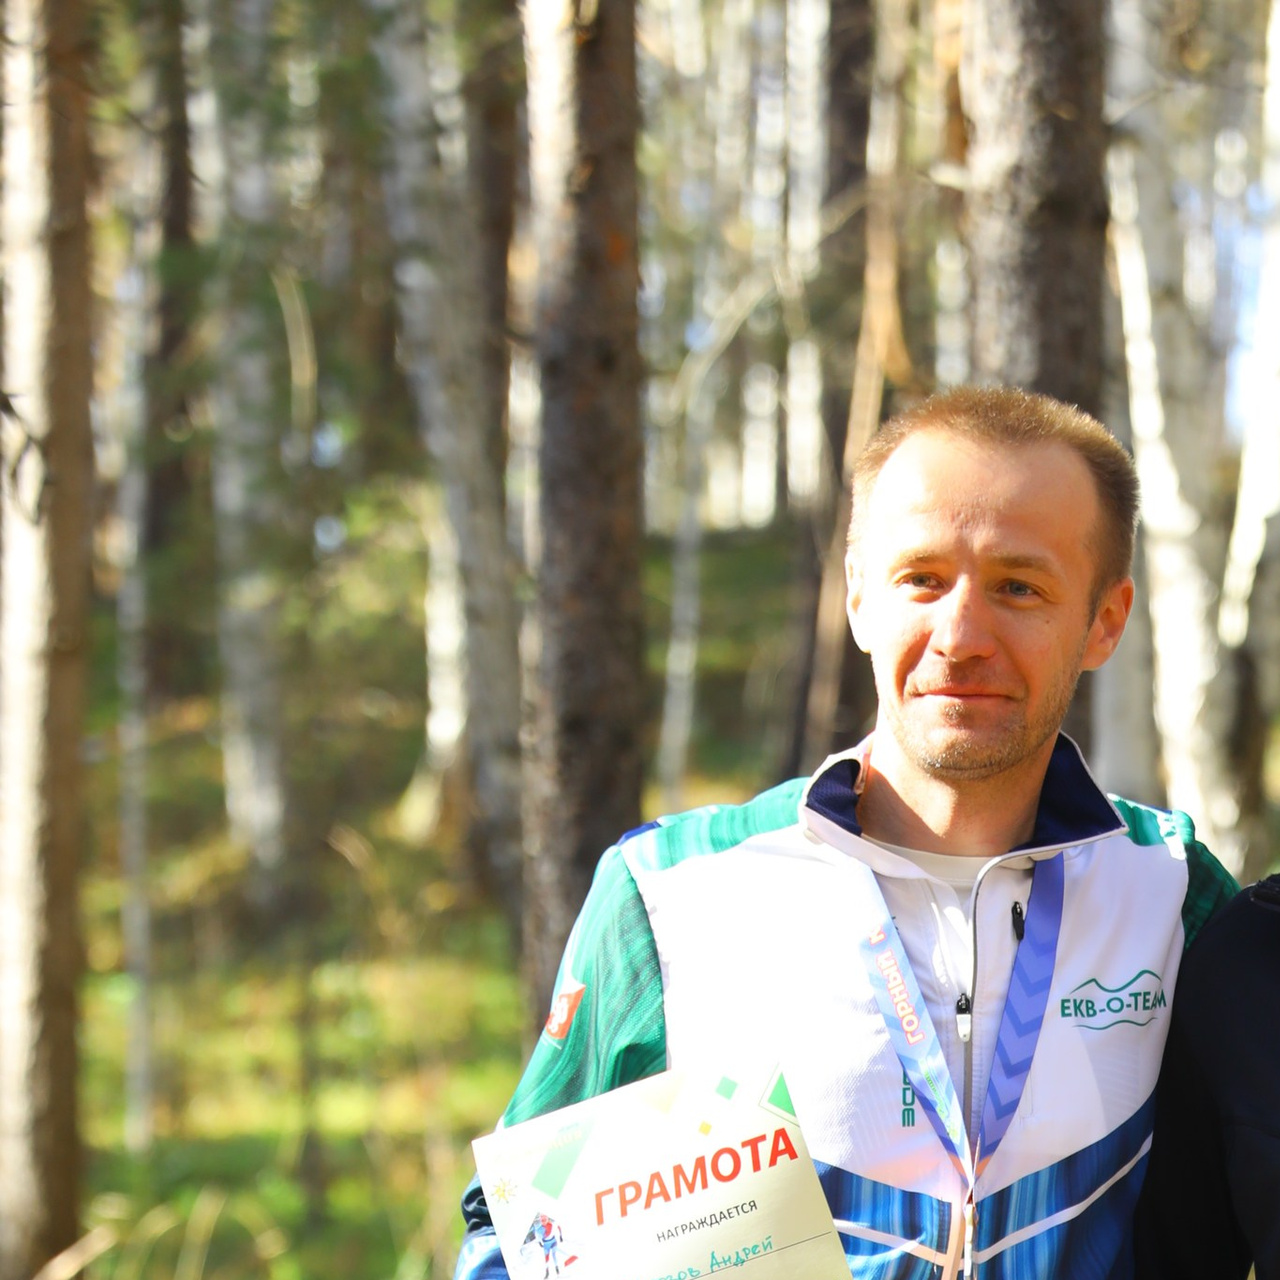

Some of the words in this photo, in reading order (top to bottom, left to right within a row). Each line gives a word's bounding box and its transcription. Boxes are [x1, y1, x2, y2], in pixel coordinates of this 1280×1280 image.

[876, 948, 926, 1046] ГОРНЫЙ
[594, 1127, 799, 1227] ГРАМОТА
[656, 1199, 758, 1243] НАГРАЖДАЕТСЯ
